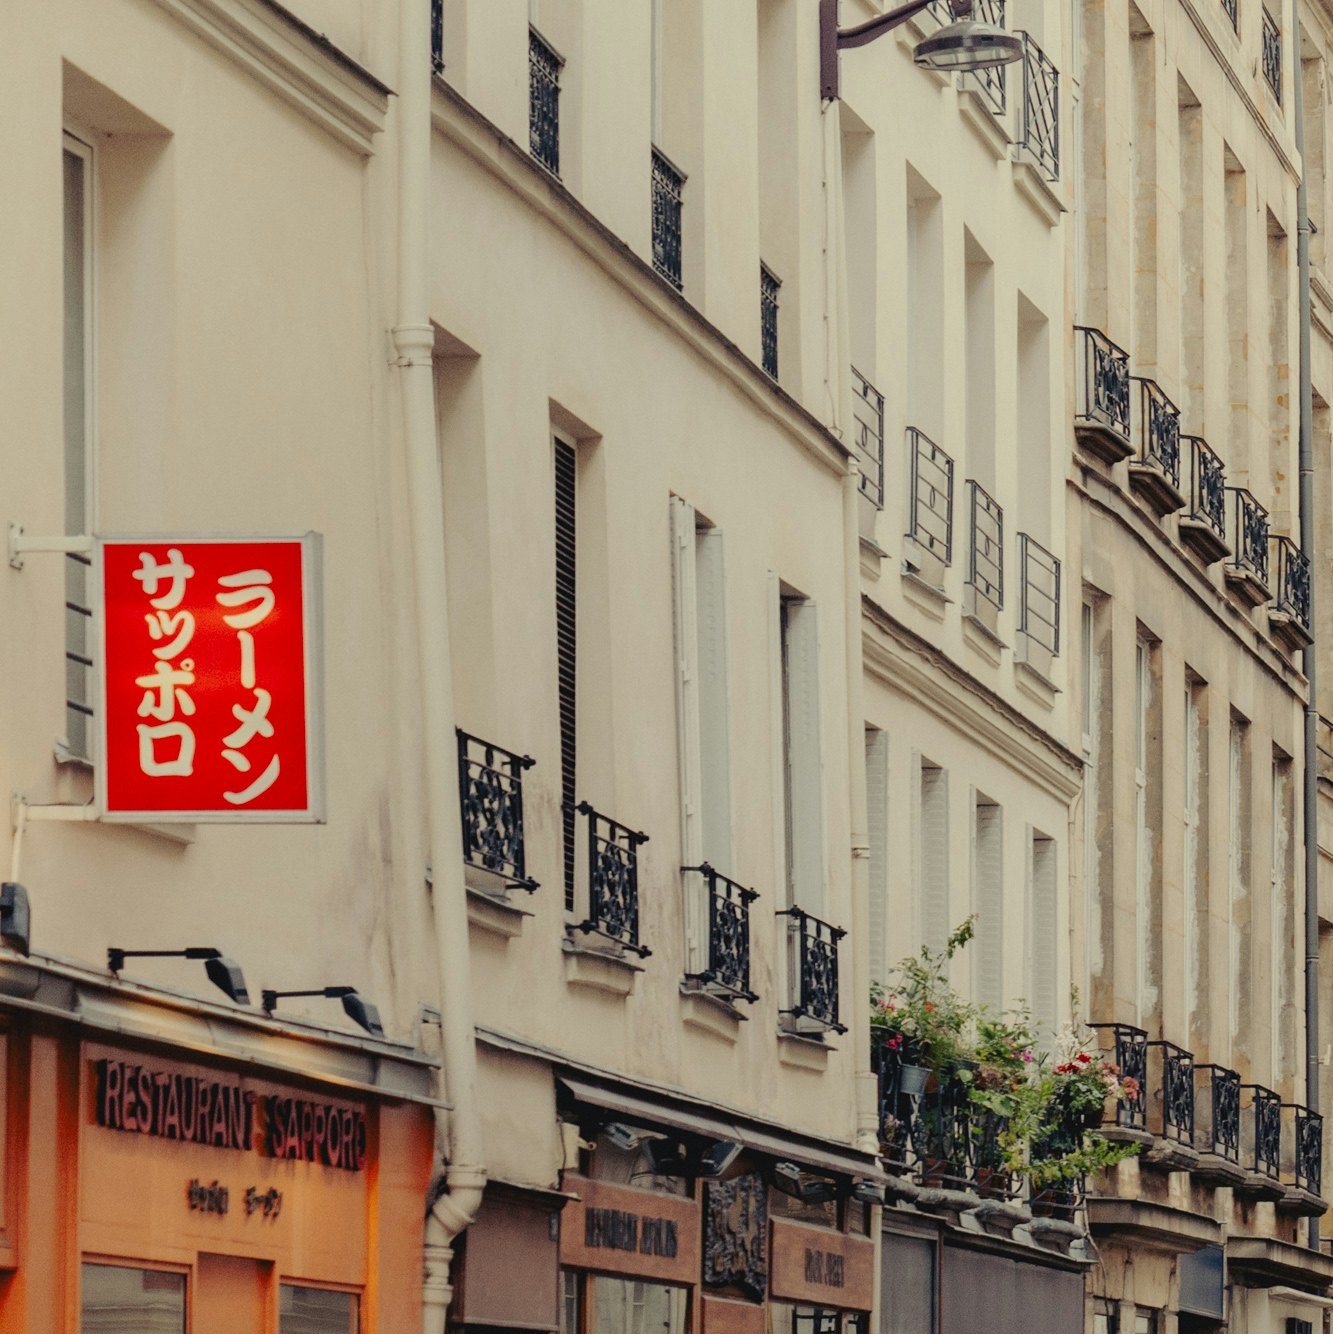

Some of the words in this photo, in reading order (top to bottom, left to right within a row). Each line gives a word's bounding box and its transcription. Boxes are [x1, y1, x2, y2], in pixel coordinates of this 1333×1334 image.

[131, 548, 196, 777] サッポロ
[215, 568, 281, 805] ラーメン
[99, 1059, 259, 1151] RESTAURANT
[268, 1095, 366, 1171] SAPPORO
